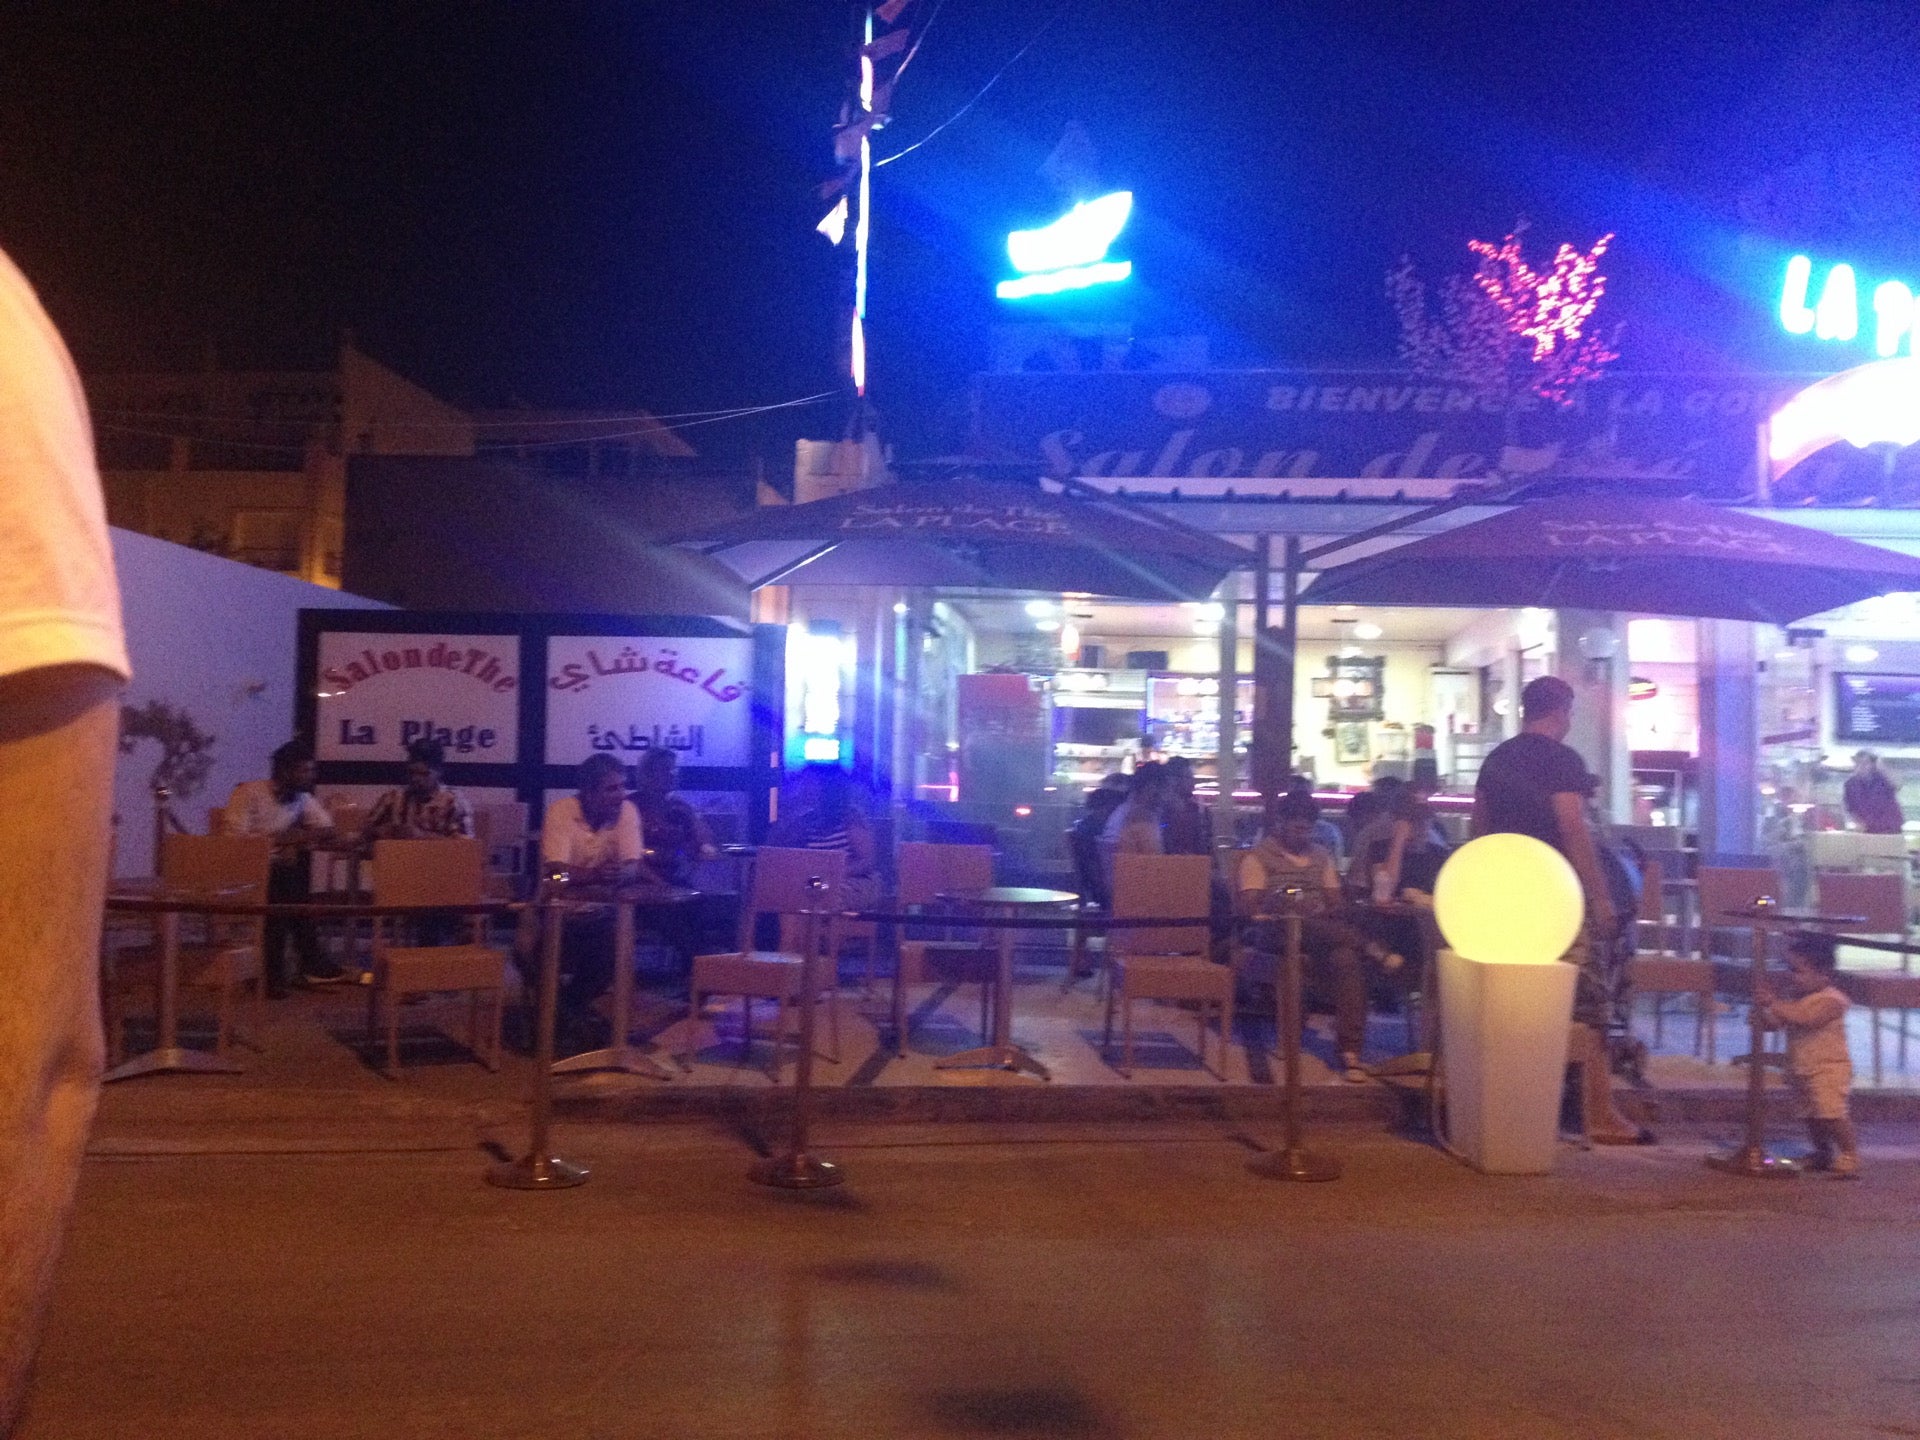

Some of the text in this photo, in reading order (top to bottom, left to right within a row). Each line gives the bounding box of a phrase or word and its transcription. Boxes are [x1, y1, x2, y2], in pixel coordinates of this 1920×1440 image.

[1778, 252, 1858, 341] LA
[1037, 427, 1320, 482] Salon
[1359, 430, 1486, 480] de
[339, 718, 497, 754] La Plage
